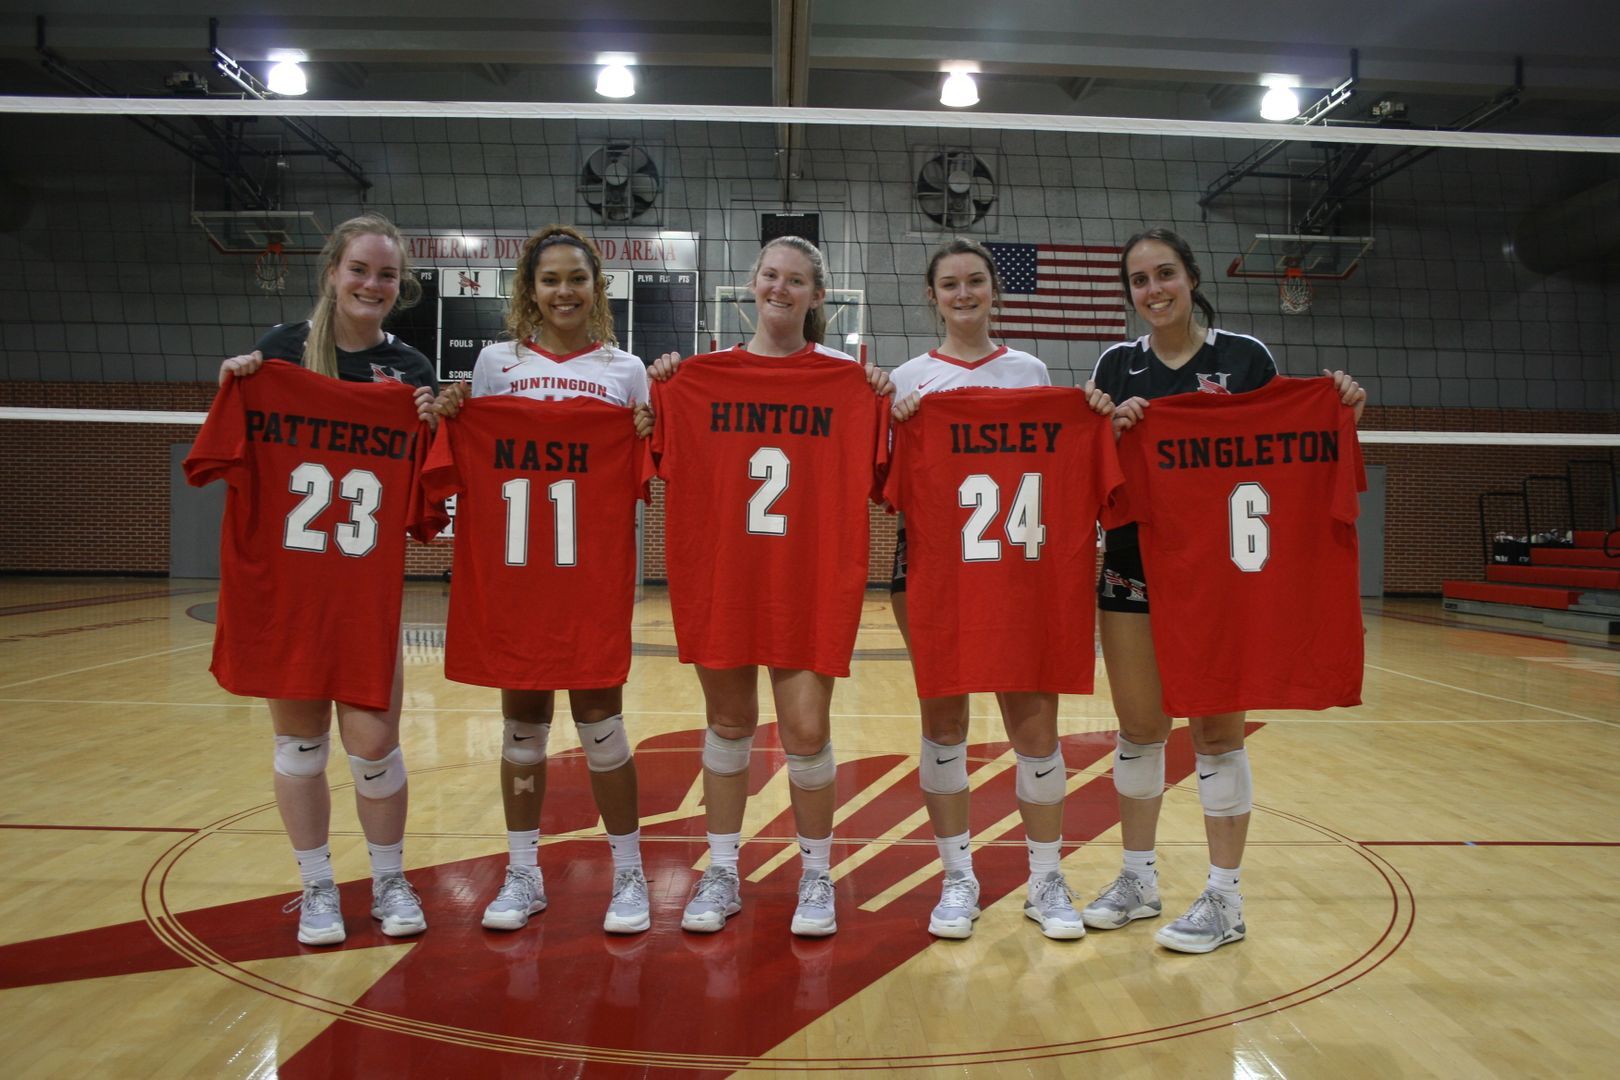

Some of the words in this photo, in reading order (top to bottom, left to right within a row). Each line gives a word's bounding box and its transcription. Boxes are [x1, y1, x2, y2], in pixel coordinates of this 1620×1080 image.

[619, 240, 677, 261] ARENA
[420, 272, 432, 280] PTS
[637, 275, 653, 283] PLYR
[678, 275, 690, 283] PTS
[449, 340, 473, 348] FOULS
[510, 376, 607, 398] HUNTINGDON
[710, 402, 833, 437] HINTON
[950, 422, 1062, 454] ILSLEY
[1157, 431, 1339, 470] SINGLETON
[494, 439, 589, 473] NASH
[746, 446, 791, 537] 2
[283, 462, 383, 557] 23
[501, 478, 577, 567] 11
[957, 472, 1047, 563] 24
[1228, 481, 1271, 573] 6
